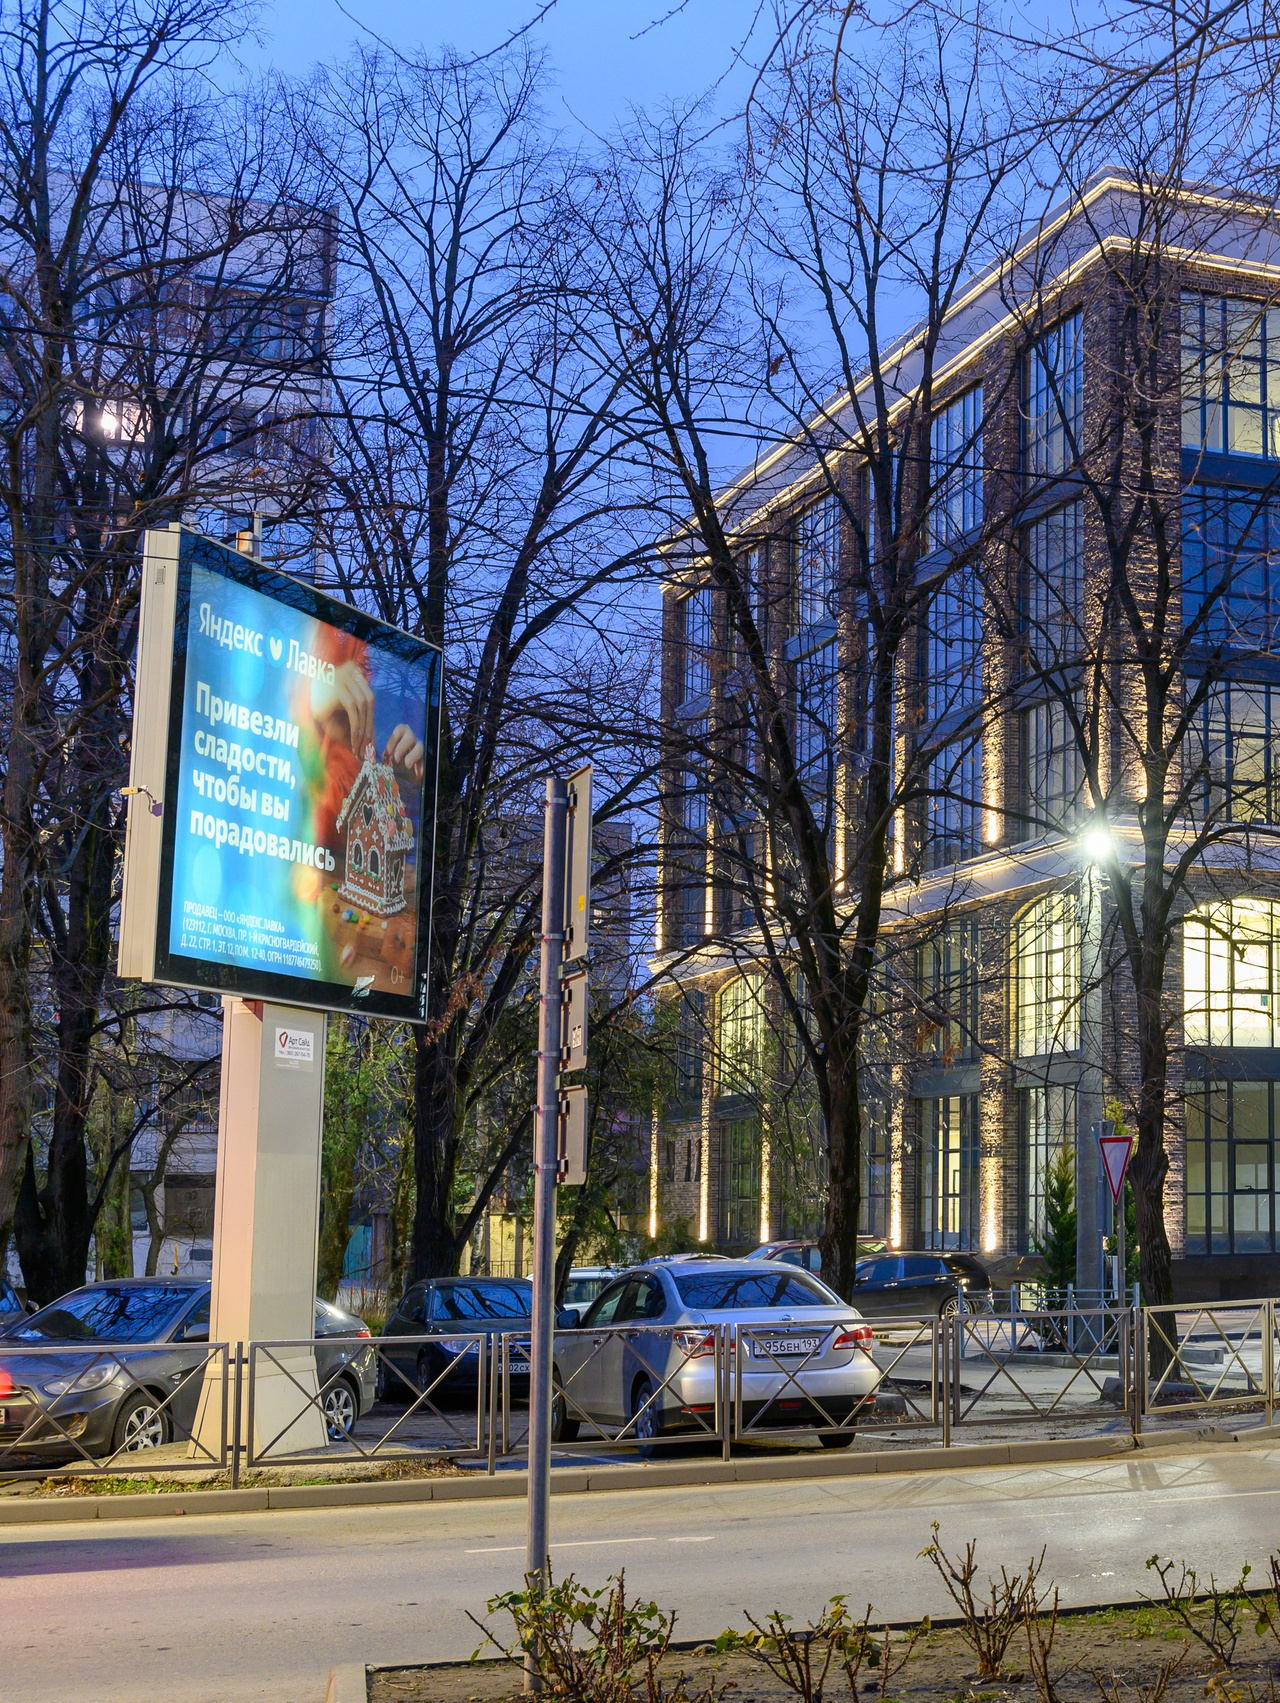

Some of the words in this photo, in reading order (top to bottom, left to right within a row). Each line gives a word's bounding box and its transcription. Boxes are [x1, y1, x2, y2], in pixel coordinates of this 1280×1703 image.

[199, 602, 264, 658] Яндекс
[286, 638, 336, 687] Лавка
[196, 680, 300, 748] Привезли
[194, 730, 297, 790] сладости,
[192, 769, 257, 813] чтобы
[261, 791, 290, 822] вы
[190, 810, 336, 872] порадовались
[183, 900, 218, 921] ПРОДАВЕЦ
[391, 965, 405, 985] 0+
[801, 1339, 818, 1348] 193
